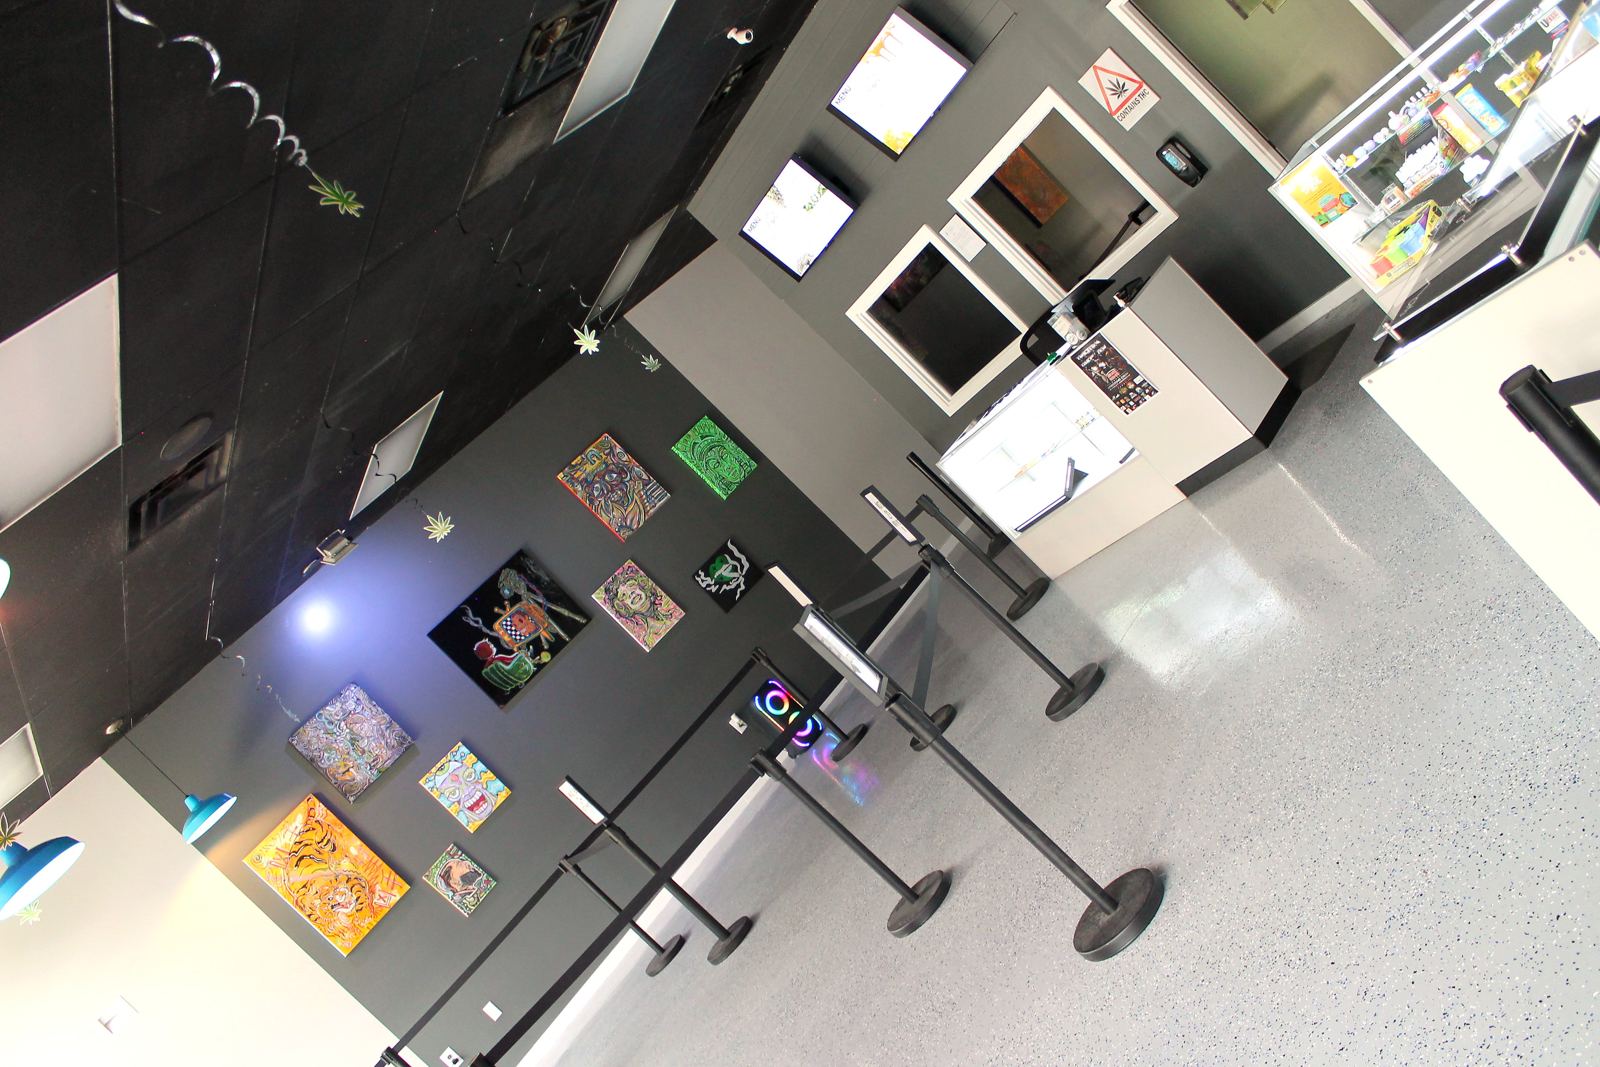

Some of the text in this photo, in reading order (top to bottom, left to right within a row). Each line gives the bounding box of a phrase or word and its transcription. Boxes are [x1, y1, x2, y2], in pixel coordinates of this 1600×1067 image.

[835, 86, 851, 105] MENU
[1117, 88, 1150, 122] CONTAINS THC
[747, 215, 761, 233] MENU
